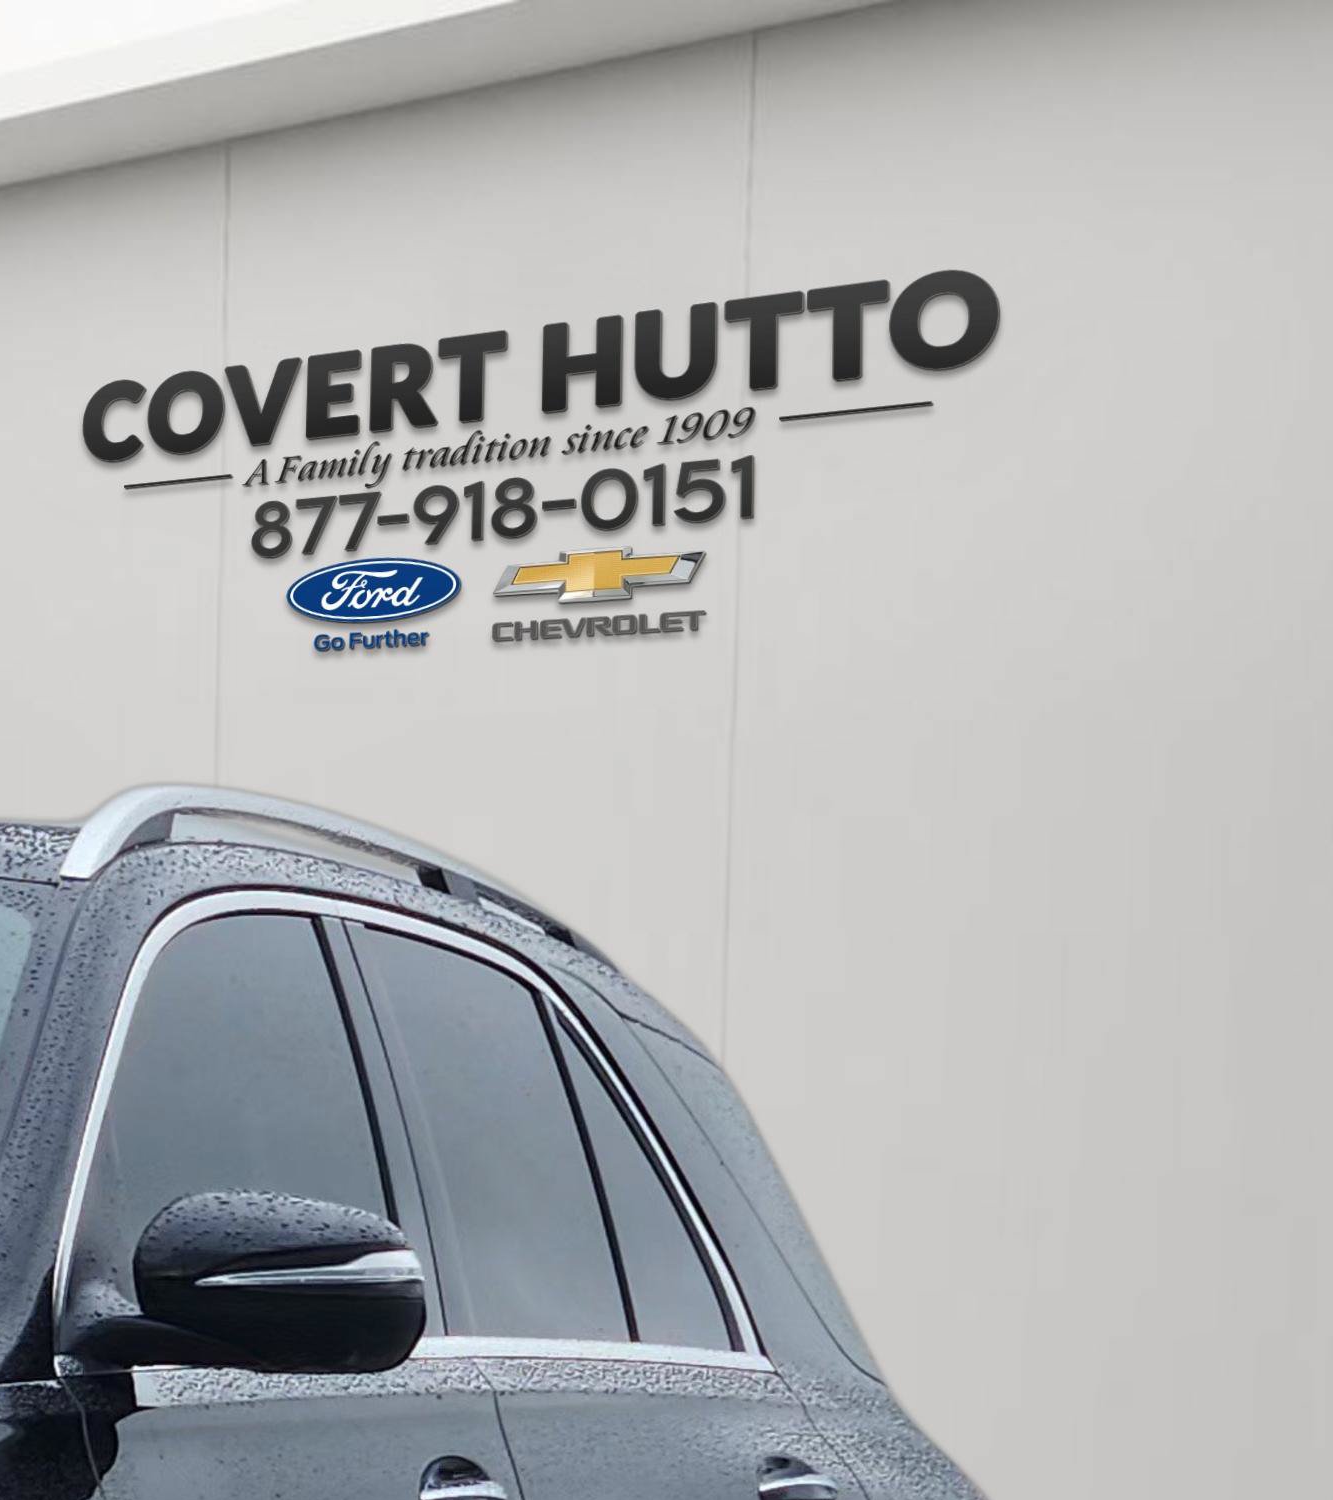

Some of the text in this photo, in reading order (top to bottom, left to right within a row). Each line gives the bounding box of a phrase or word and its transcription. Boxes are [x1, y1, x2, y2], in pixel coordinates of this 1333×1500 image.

[81, 268, 1002, 466] COVERT HUTTO
[241, 405, 757, 490] A Family tradition since 1909
[249, 454, 756, 561] 877-918-0151
[317, 569, 425, 613] Ford
[313, 627, 430, 654] Go Further
[491, 610, 708, 644] CHEVROLET
